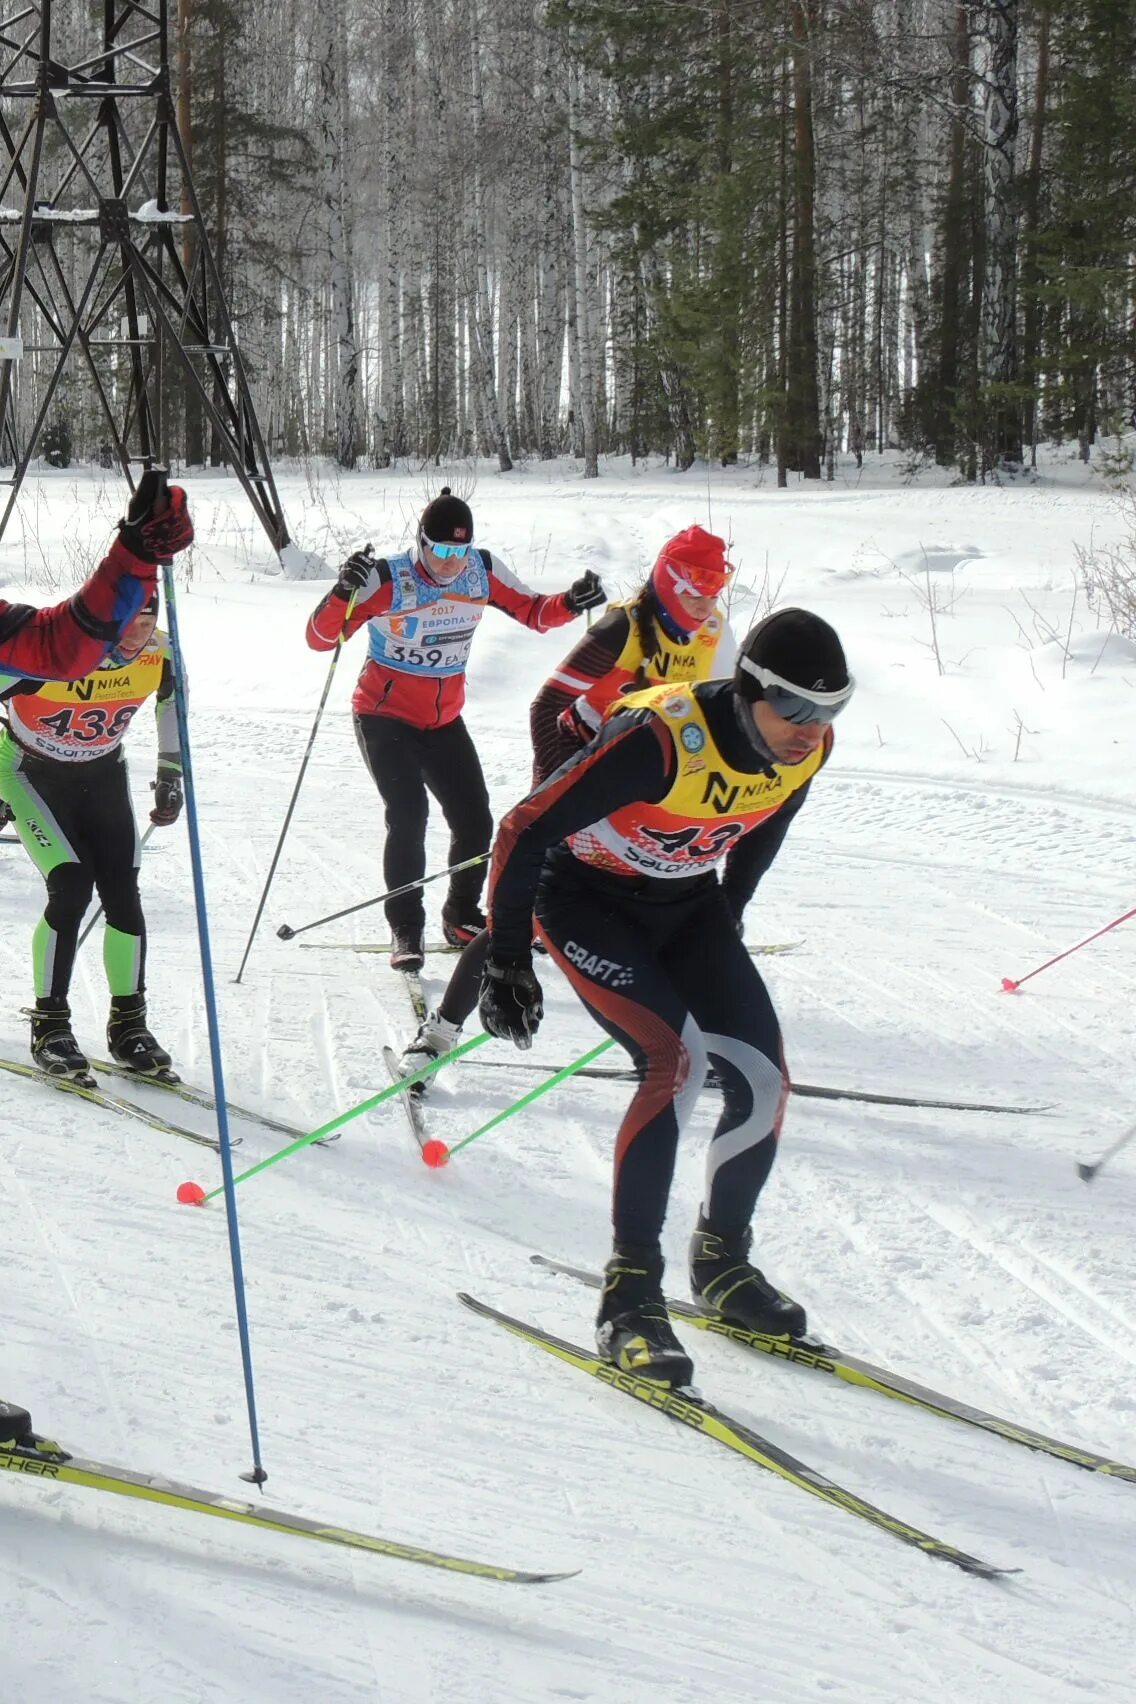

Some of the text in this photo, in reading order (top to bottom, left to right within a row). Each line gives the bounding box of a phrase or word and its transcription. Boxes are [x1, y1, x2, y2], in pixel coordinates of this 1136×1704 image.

[431, 605, 455, 616] 2017
[392, 645, 443, 668] 359
[97, 676, 131, 690] NIKA
[39, 705, 140, 742] 438
[741, 775, 783, 798] NIKA
[564, 940, 623, 981] CRAFT
[706, 1322, 836, 1374] FISCHER
[595, 1366, 705, 1426] FISCHER
